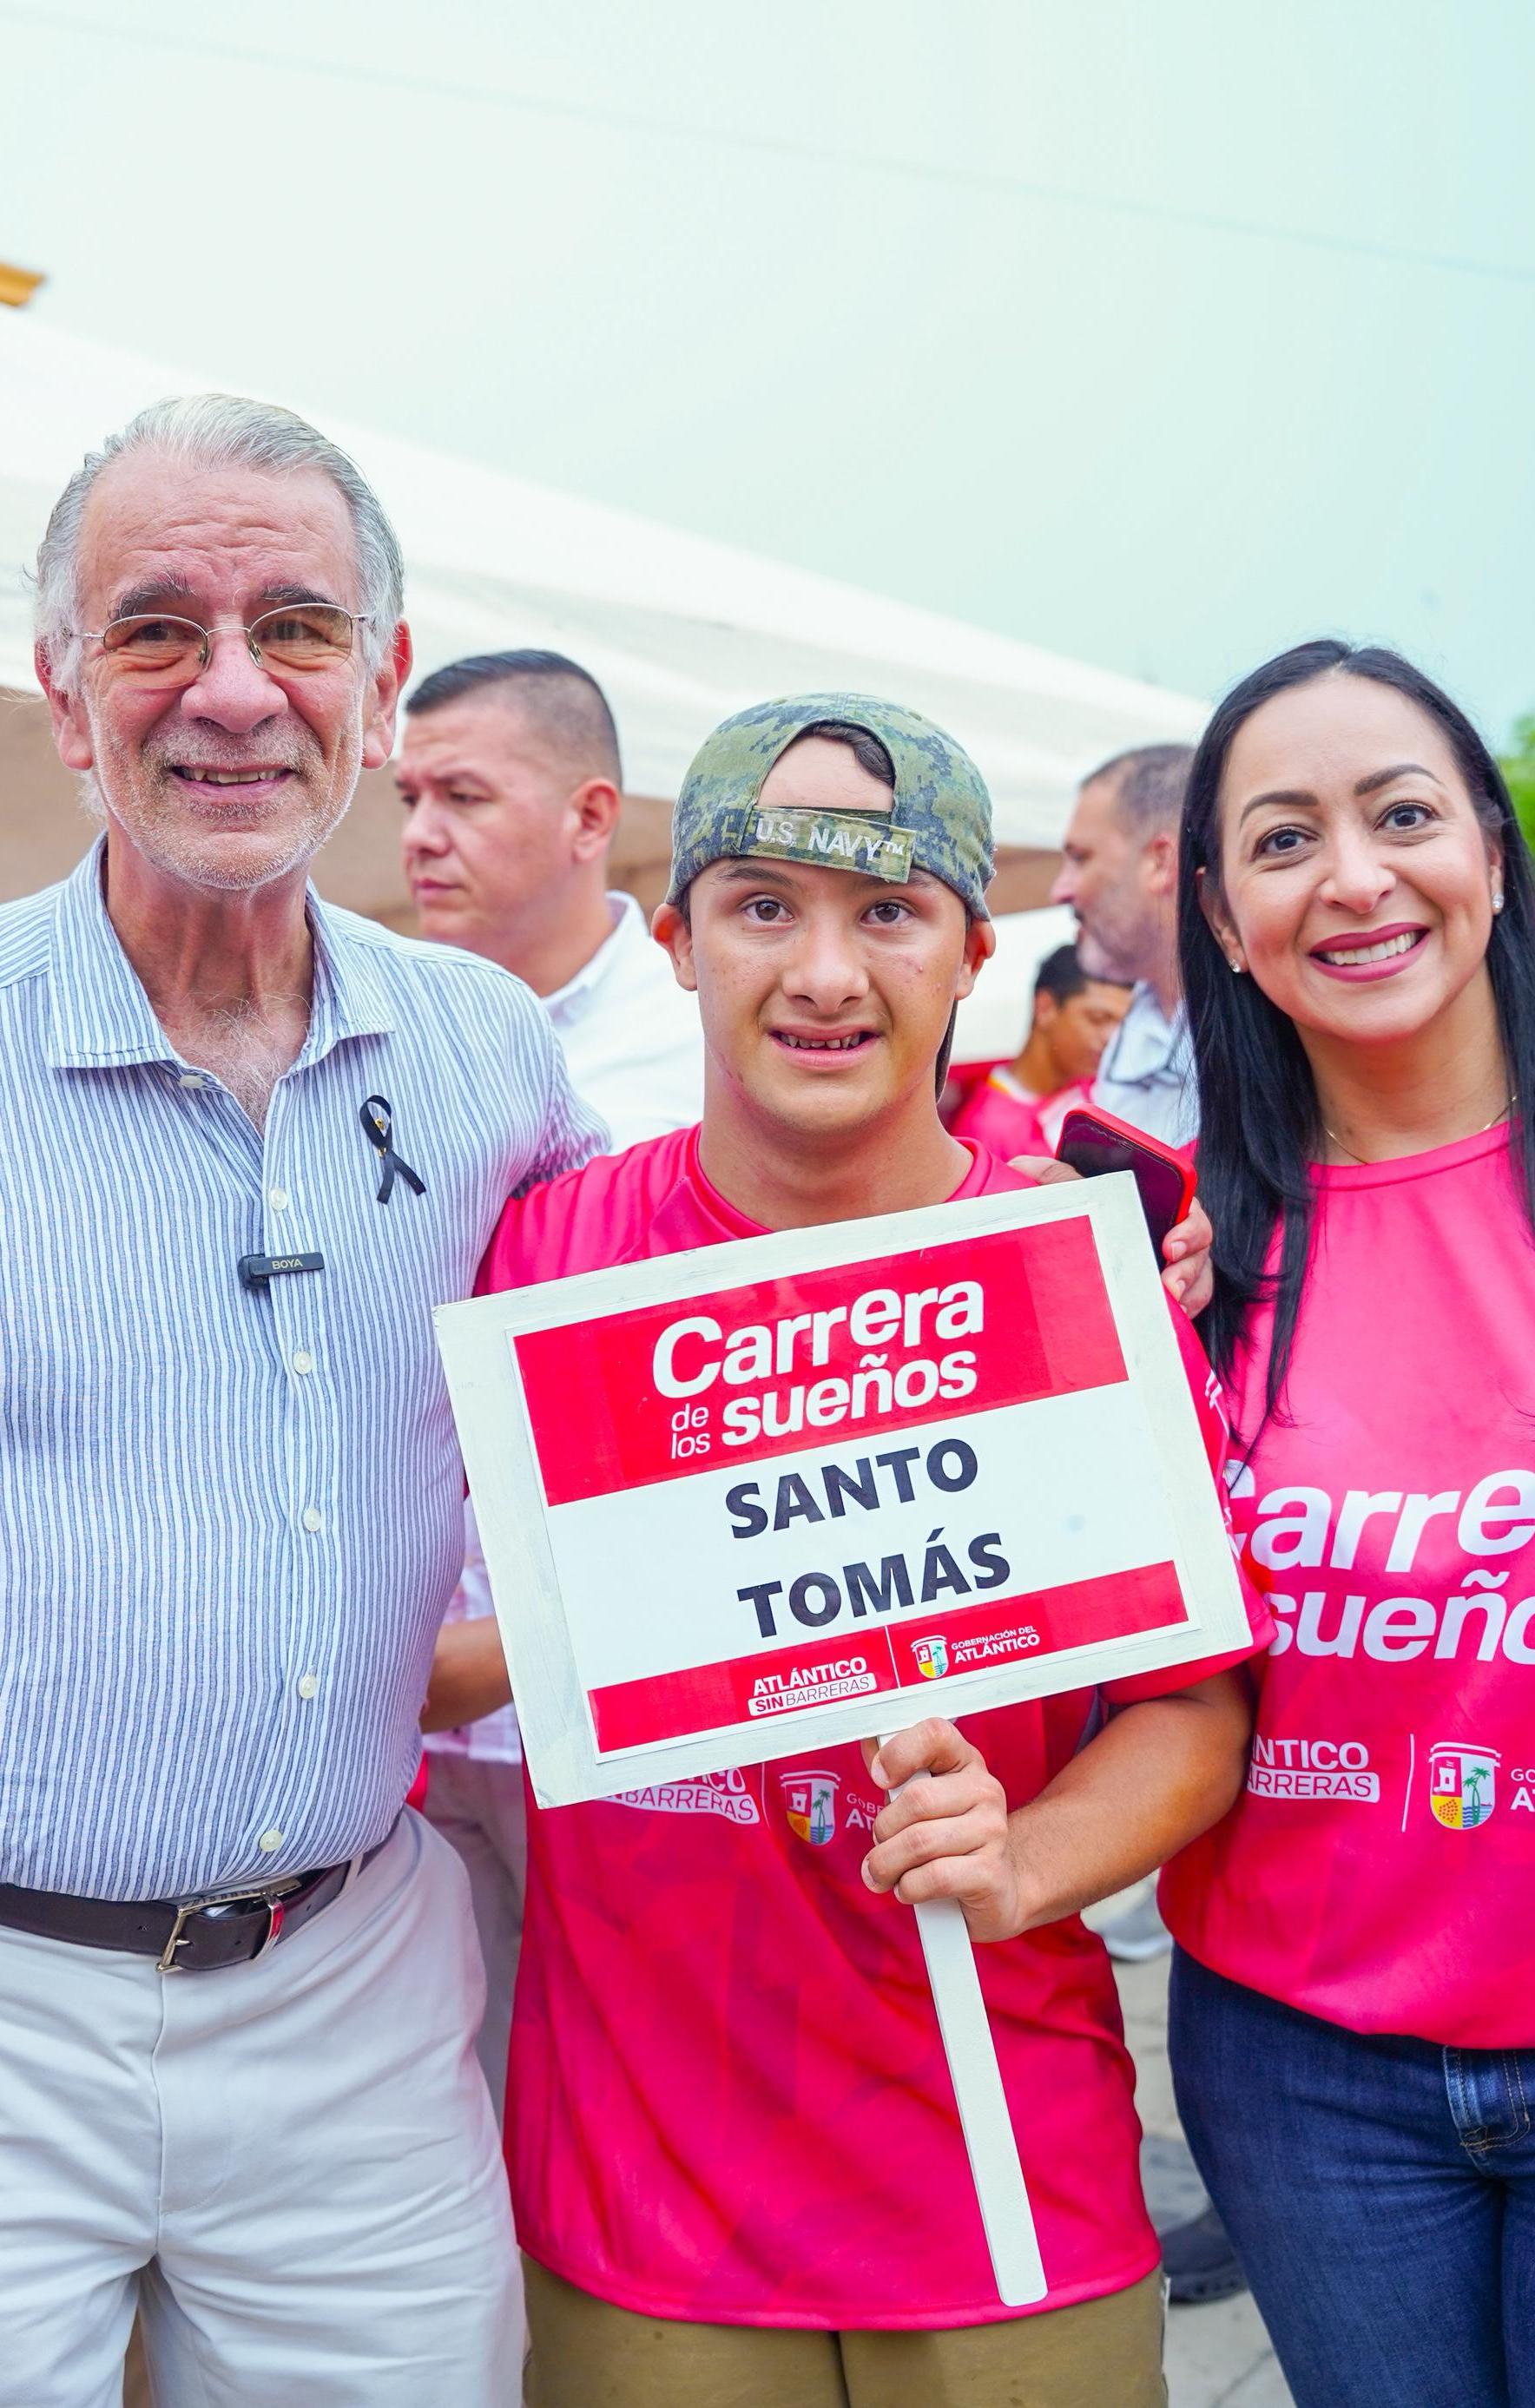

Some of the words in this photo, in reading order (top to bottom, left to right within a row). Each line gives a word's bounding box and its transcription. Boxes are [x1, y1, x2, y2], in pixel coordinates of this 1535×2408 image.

[756, 818, 797, 847] U.S.
[272, 1259, 303, 1269] BOYA
[652, 1280, 985, 1398] Carrera
[671, 1431, 710, 1459] los
[721, 1350, 978, 1446] sueños
[671, 1403, 709, 1432] de
[726, 1438, 978, 1539] SANTO
[737, 1527, 1011, 1638] TOMÁS
[951, 1629, 1017, 1650] GOBERNACIÓN
[1018, 1625, 1037, 1635] DEL
[955, 1634, 1040, 1664] ATLÁNTICO
[753, 1656, 867, 1697] ATLÁNTICO
[1253, 1733, 1369, 1770] NTICO
